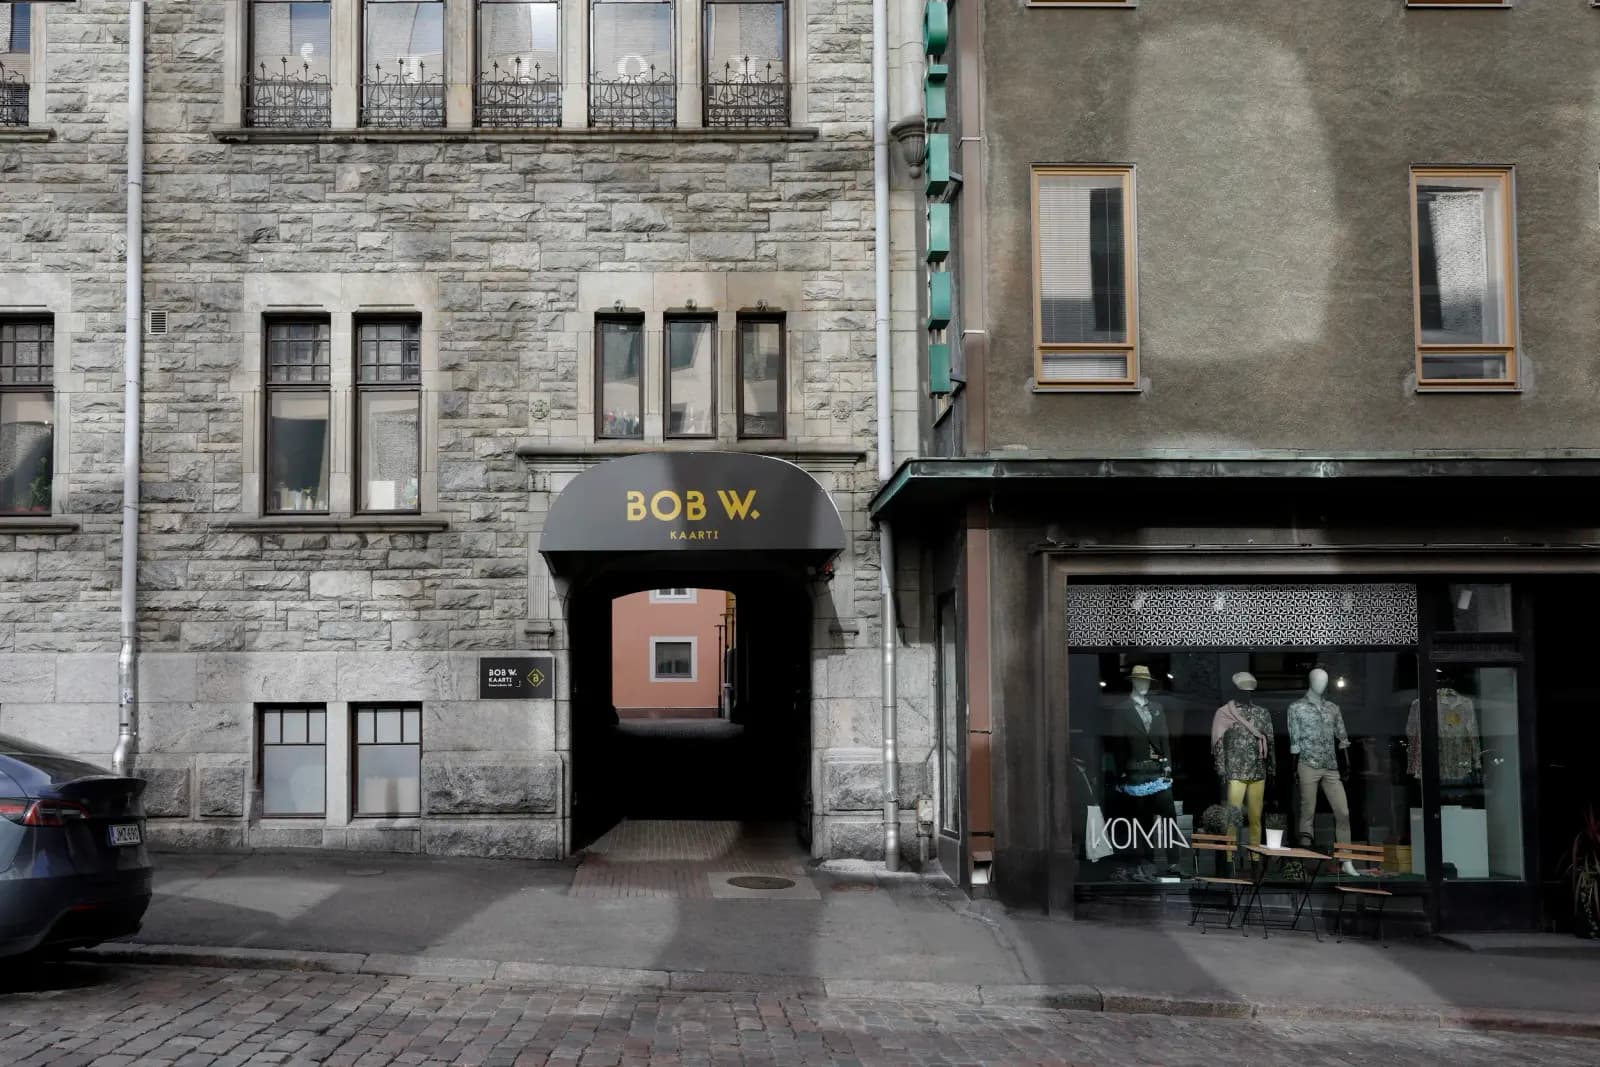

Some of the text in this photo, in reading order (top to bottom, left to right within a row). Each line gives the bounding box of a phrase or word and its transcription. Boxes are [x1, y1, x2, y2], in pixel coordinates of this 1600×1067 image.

[626, 490, 761, 521] BOB W.
[670, 530, 720, 540] KAARTI
[1091, 817, 1191, 850] KOMIA
